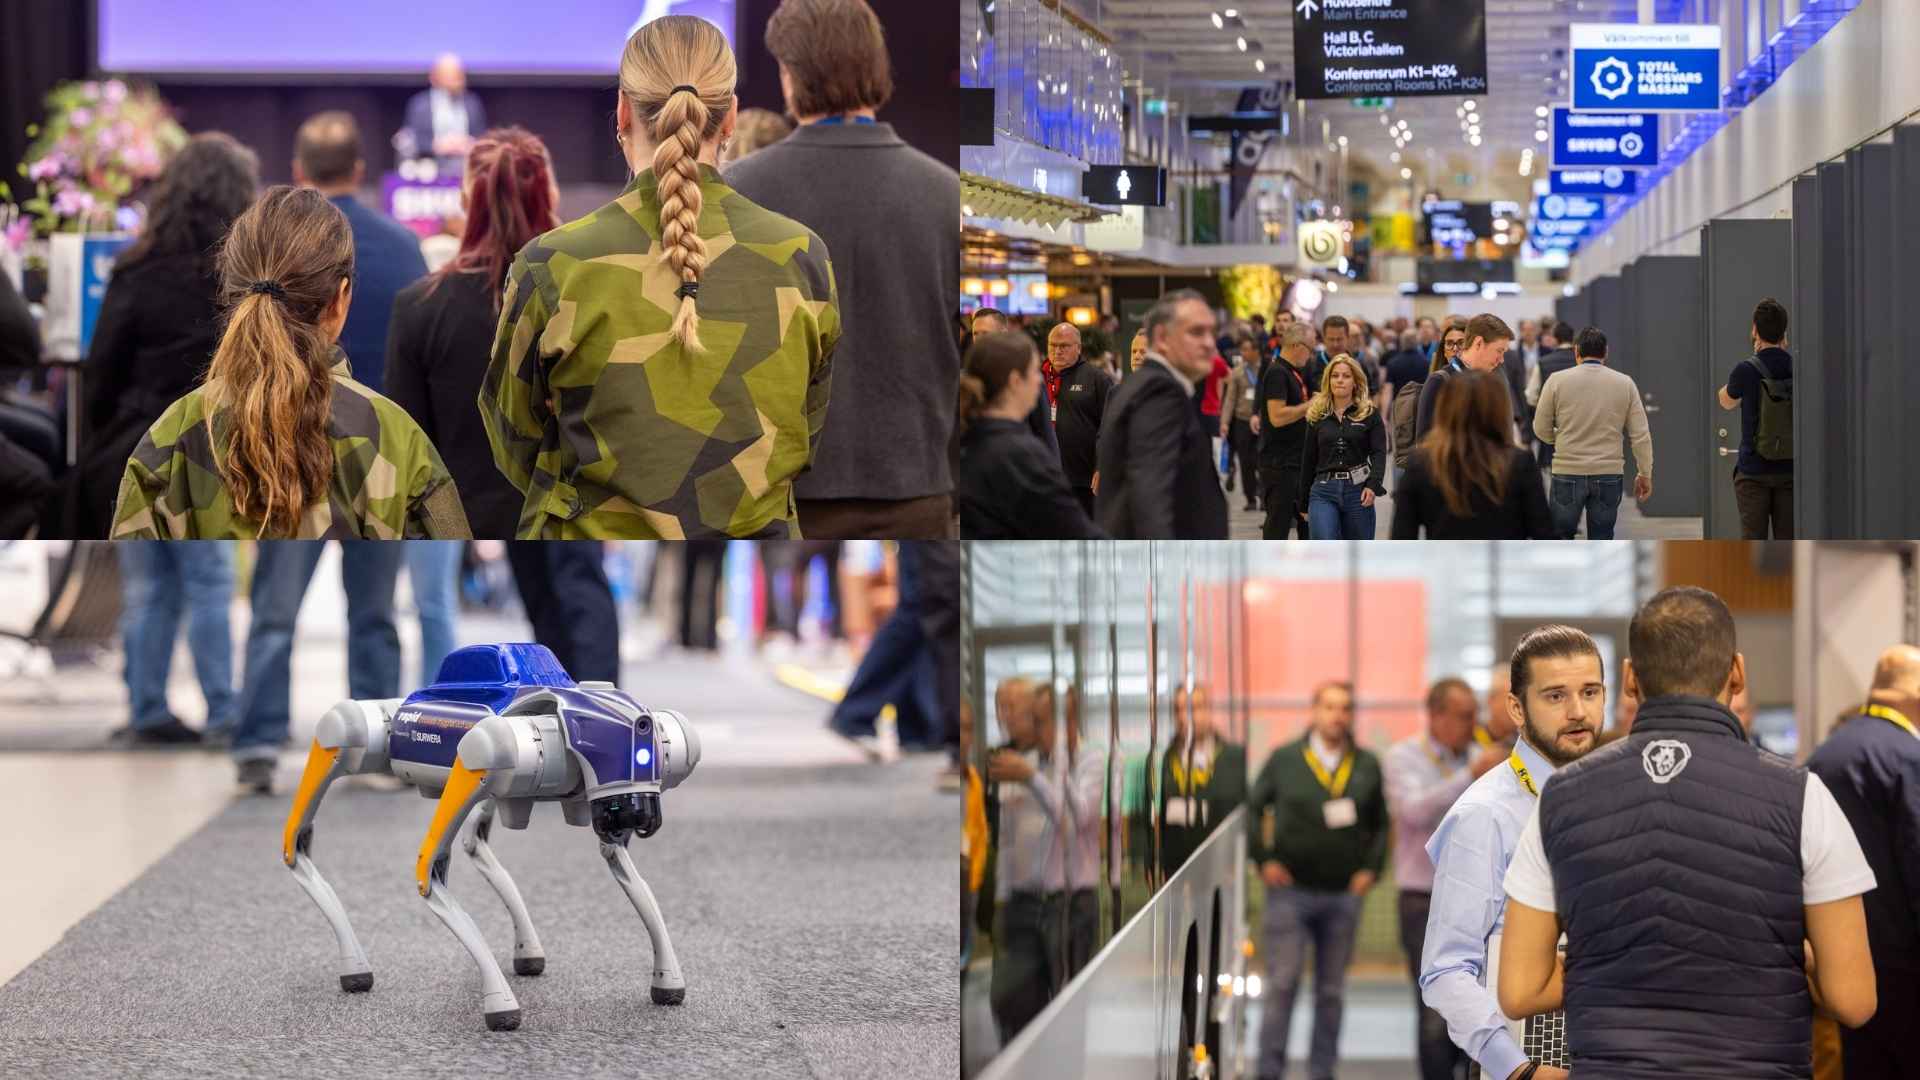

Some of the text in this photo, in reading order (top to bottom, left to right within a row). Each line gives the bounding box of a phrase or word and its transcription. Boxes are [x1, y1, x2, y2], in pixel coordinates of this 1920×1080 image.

[1323, 9, 1408, 20] Main Entrance
[1323, 31, 1347, 44] Hall
[1363, 30, 1375, 43] C
[1323, 43, 1405, 57] Victoriahallen
[1324, 66, 1407, 80] Konferensrum
[1637, 61, 1679, 73] TOTAL
[1324, 80, 1393, 94] Conference
[1394, 79, 1435, 92] Rooms
